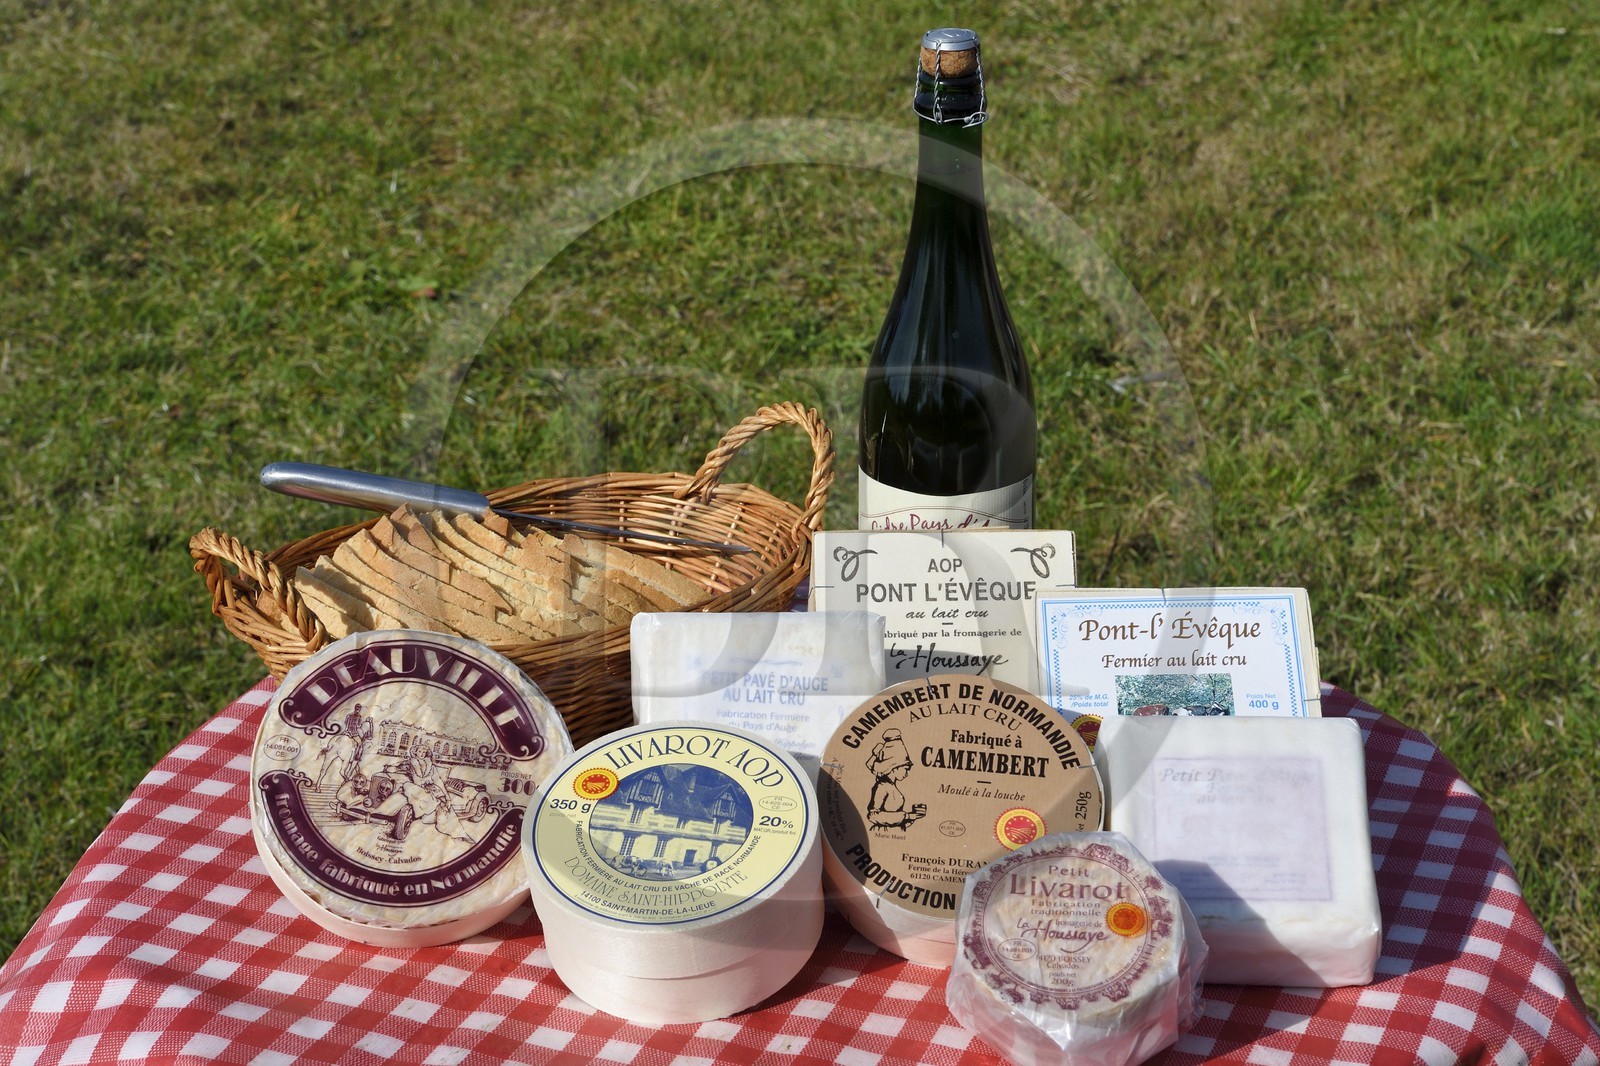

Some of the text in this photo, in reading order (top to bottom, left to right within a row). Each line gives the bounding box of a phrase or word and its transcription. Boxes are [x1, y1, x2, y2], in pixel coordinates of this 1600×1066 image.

[910, 513, 953, 530] Pays
[927, 558, 963, 573] AOP
[856, 577, 1036, 603] PONT L'ÉVÊQUE
[931, 607, 960, 619] lait
[954, 628, 1006, 639] fromagerie
[1010, 628, 1022, 636] de
[1079, 611, 1261, 649] Pont-l' Évêque
[896, 643, 1008, 676] Houssaye
[1101, 650, 1248, 668] Fermier au lait cru
[743, 671, 775, 689] PAVÉ
[780, 675, 828, 692] D'AUGE
[306, 647, 526, 737] DEAUVILLE
[723, 686, 805, 705] AU LAIT CRU
[1248, 699, 1280, 710] 400 g
[717, 709, 810, 722] Fabrication Fermière
[909, 702, 1023, 732] AU LAIT CRU
[743, 721, 764, 731] Pays
[766, 722, 797, 733] d'Auge
[842, 683, 1081, 771] CAMEMBERT DE NORMANDIE
[951, 729, 1023, 749] Fabriqué à
[604, 734, 731, 770] LIVAROT
[726, 748, 784, 788] AOP
[921, 746, 1050, 778] CAMEMBERT
[938, 784, 1026, 801] Moulé à la louche
[550, 798, 592, 814] 350 g
[1074, 791, 1092, 820] 250g
[759, 815, 794, 829] 20%
[274, 791, 518, 897] fromage fabriqué en Normandie
[356, 847, 422, 865] Boissey Calvados
[575, 820, 590, 858] FABRICATION
[613, 877, 625, 886] AU
[624, 881, 642, 891] LAIT
[674, 880, 702, 891] VACHE
[702, 876, 714, 884] DE
[714, 864, 735, 879] RACE
[732, 835, 761, 867] NORMANDE
[902, 853, 946, 866] François
[845, 843, 956, 910] PRODUCTION
[908, 864, 931, 873] Ferme
[1048, 865, 1089, 878] Petit
[564, 856, 618, 899] DOMAINE
[617, 870, 748, 907] SAINT-HIPPOLYTE
[932, 874, 966, 883] CAMEM
[1010, 873, 1126, 900] Livarot
[580, 890, 602, 904] 14100
[600, 900, 717, 916] SAINT-MARTIN-DE-LA-LIEUE
[1030, 908, 1101, 917] traditionnelle
[1032, 898, 1101, 908] Fabrication
[1021, 920, 1108, 952] Houssaye
